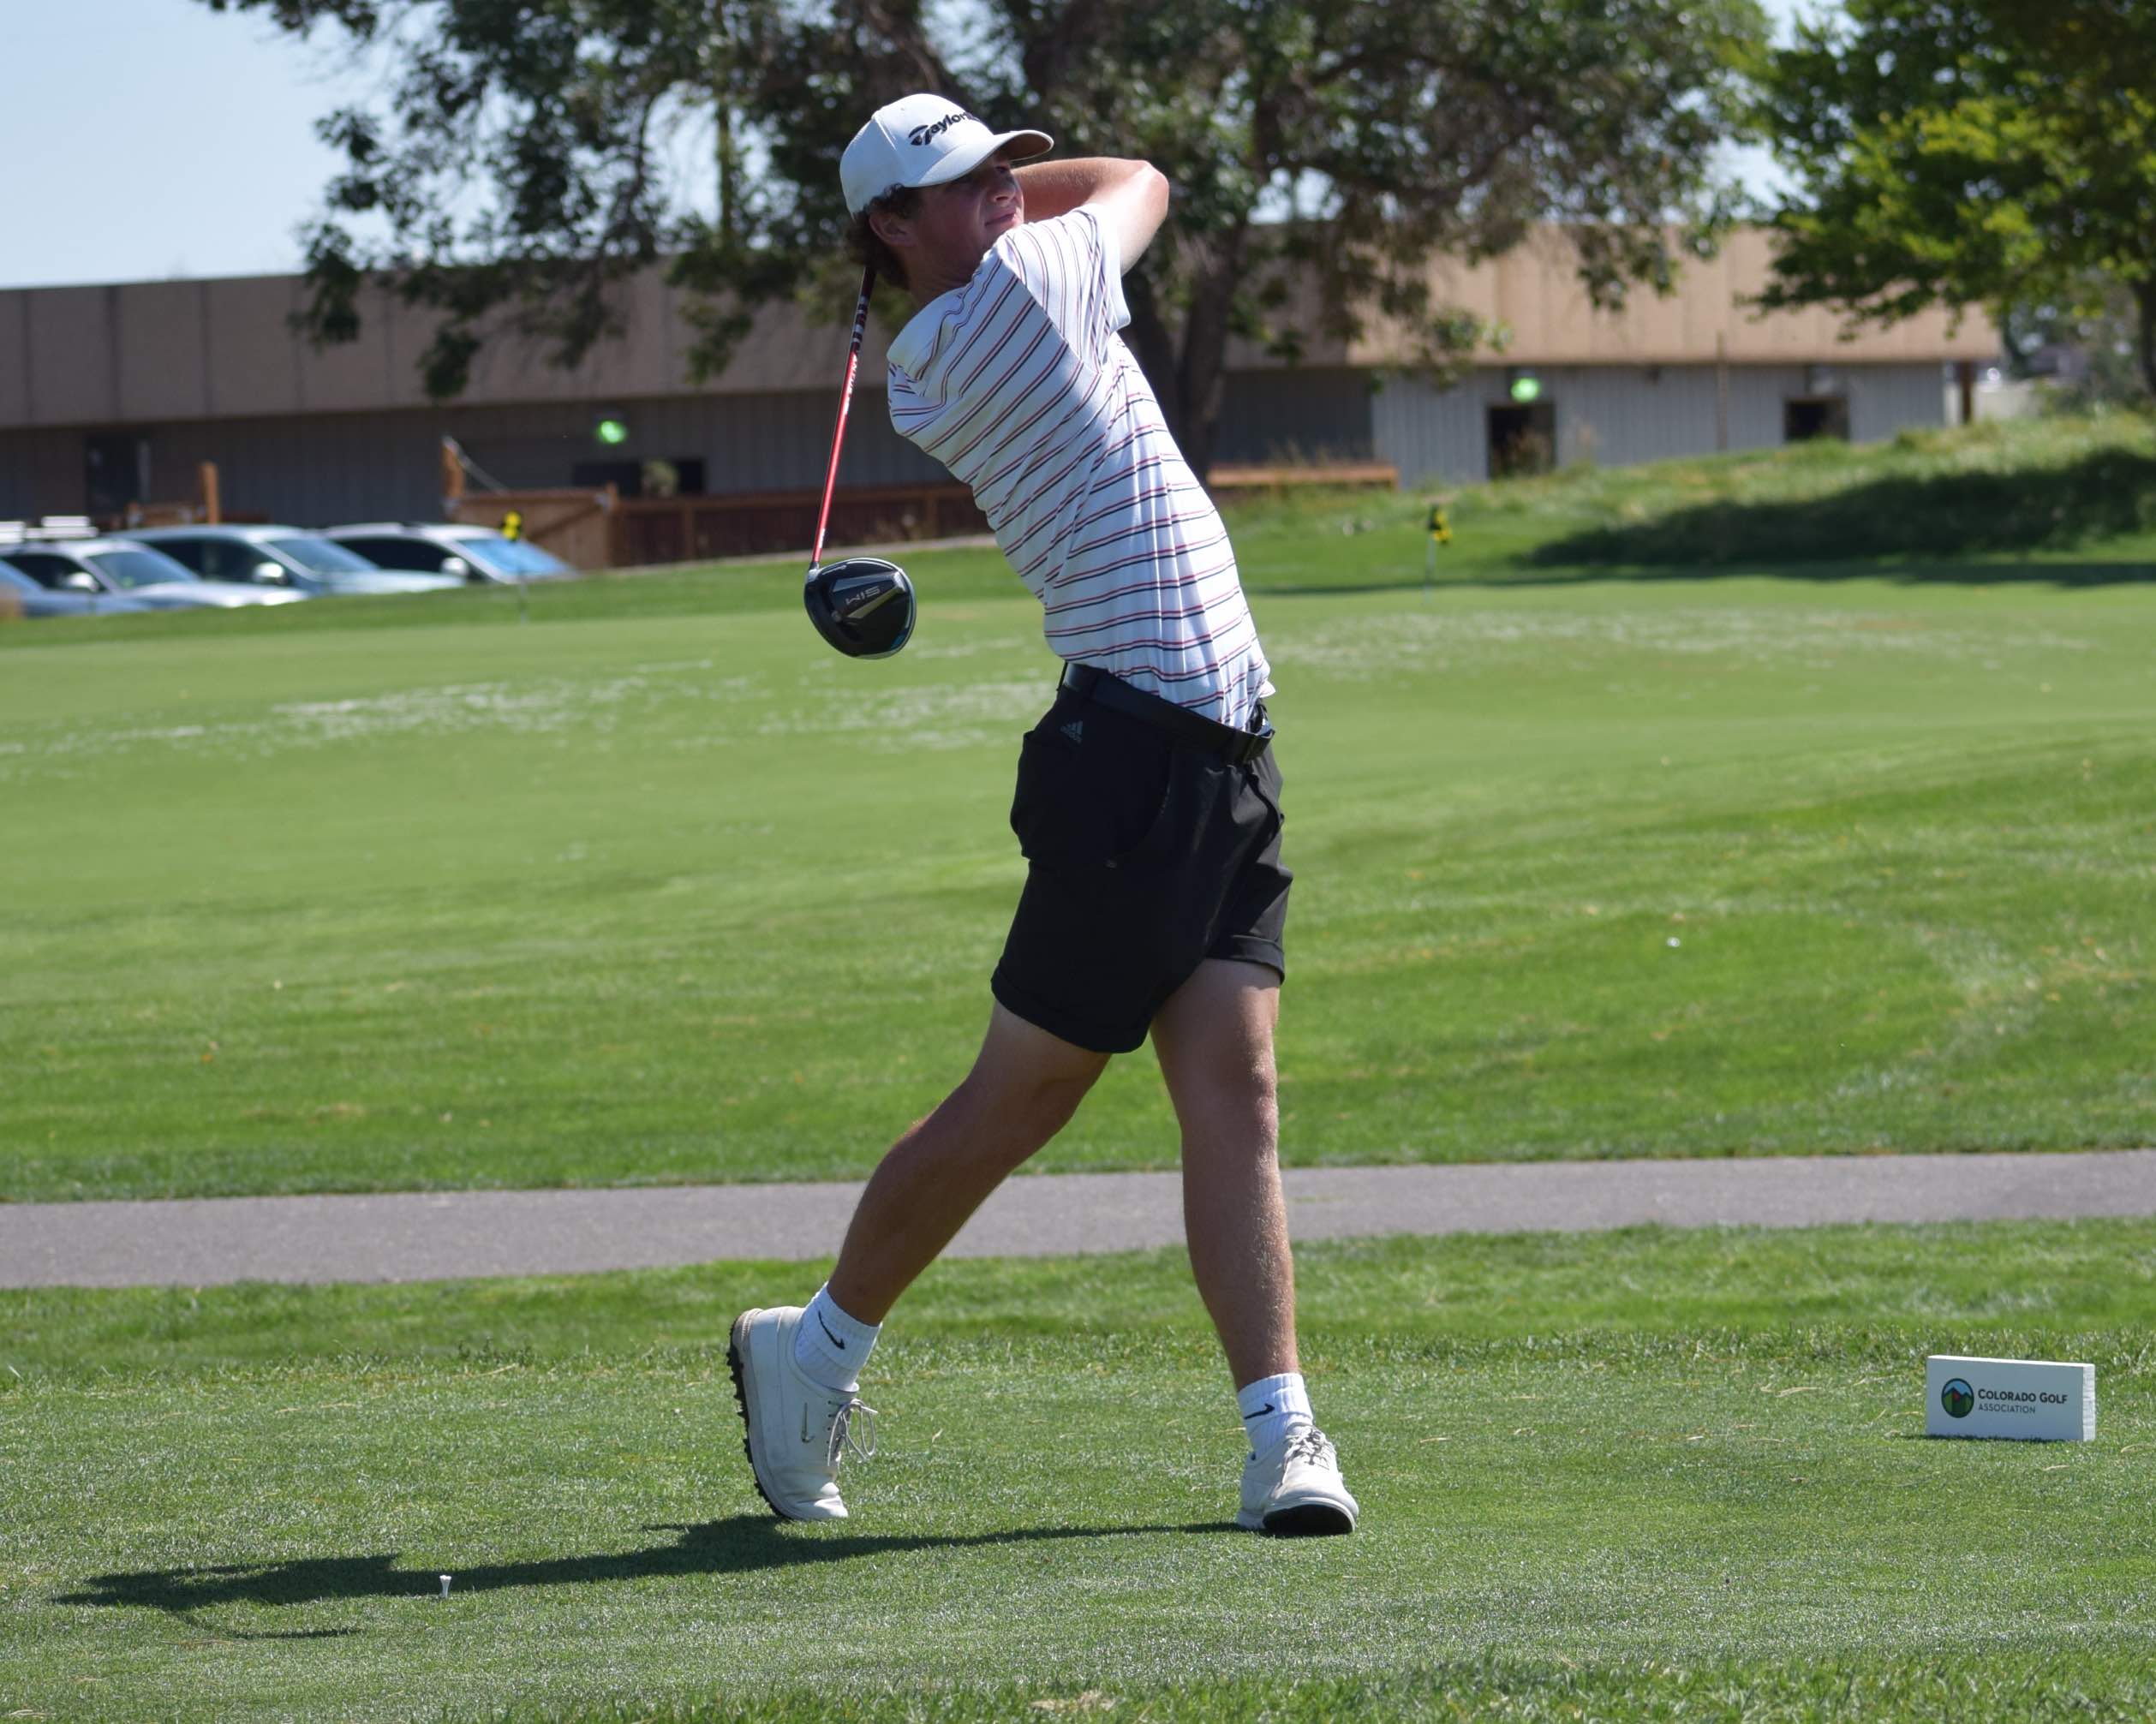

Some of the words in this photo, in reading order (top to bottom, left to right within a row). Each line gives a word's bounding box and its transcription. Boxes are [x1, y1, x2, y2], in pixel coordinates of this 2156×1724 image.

[908, 111, 977, 146] Taylor
[1978, 1388, 2036, 1402] COLORADO
[2040, 1392, 2068, 1404] GOLF
[1978, 1403, 2036, 1414] ASSOCIATION
